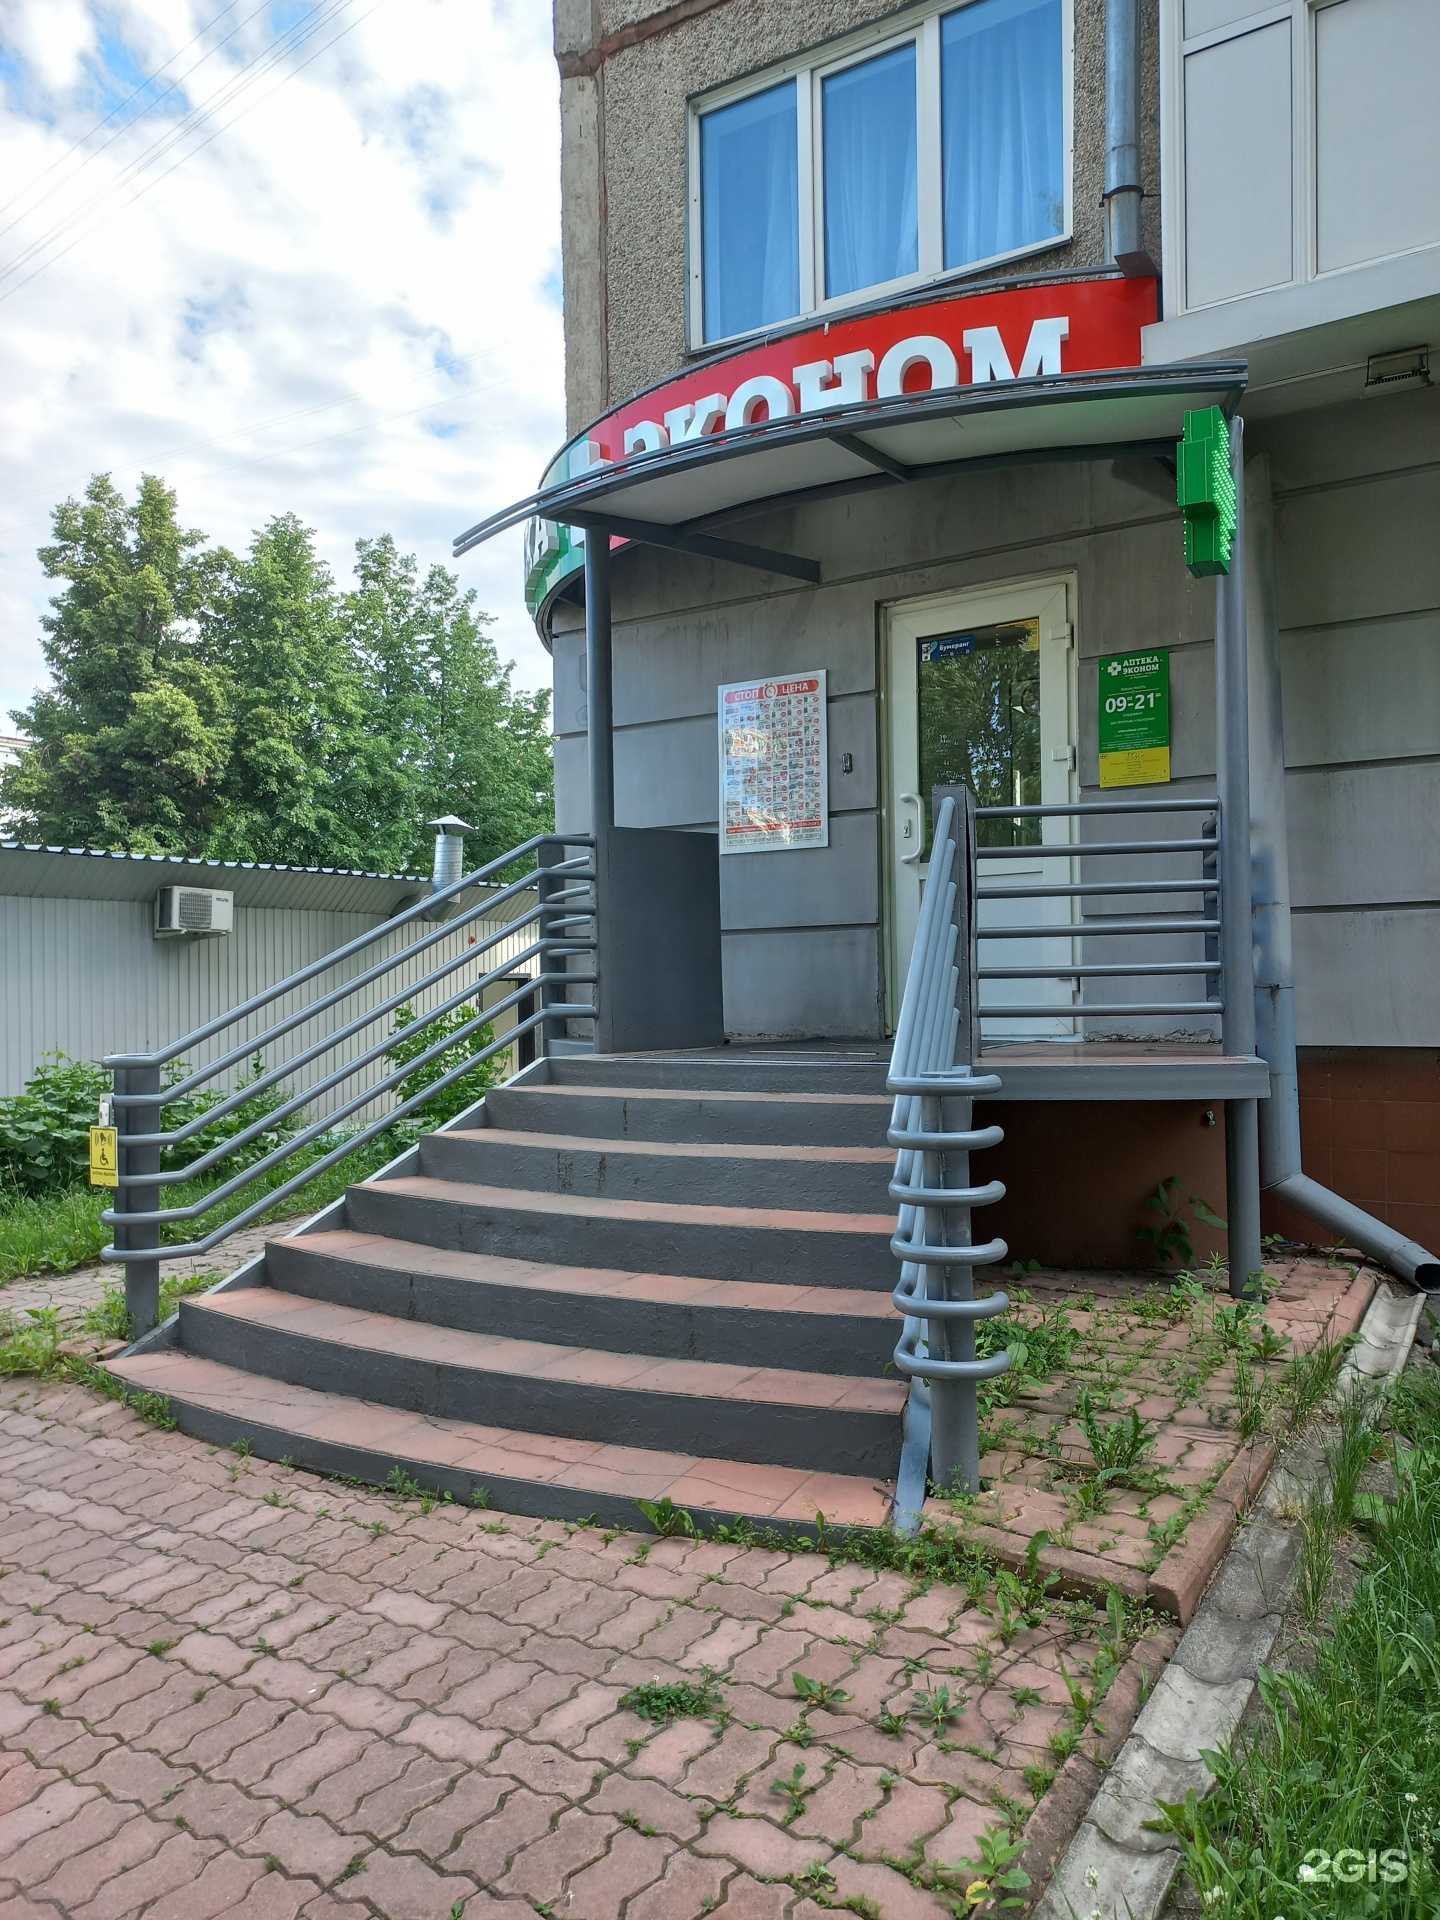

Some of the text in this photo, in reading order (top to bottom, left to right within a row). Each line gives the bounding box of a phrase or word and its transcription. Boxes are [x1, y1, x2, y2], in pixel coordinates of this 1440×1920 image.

[1122, 655, 1159, 667] АПТЕКА
[1122, 663, 1159, 674] ЭКОНОМ
[735, 682, 809, 700] СТОП ЦЕНА
